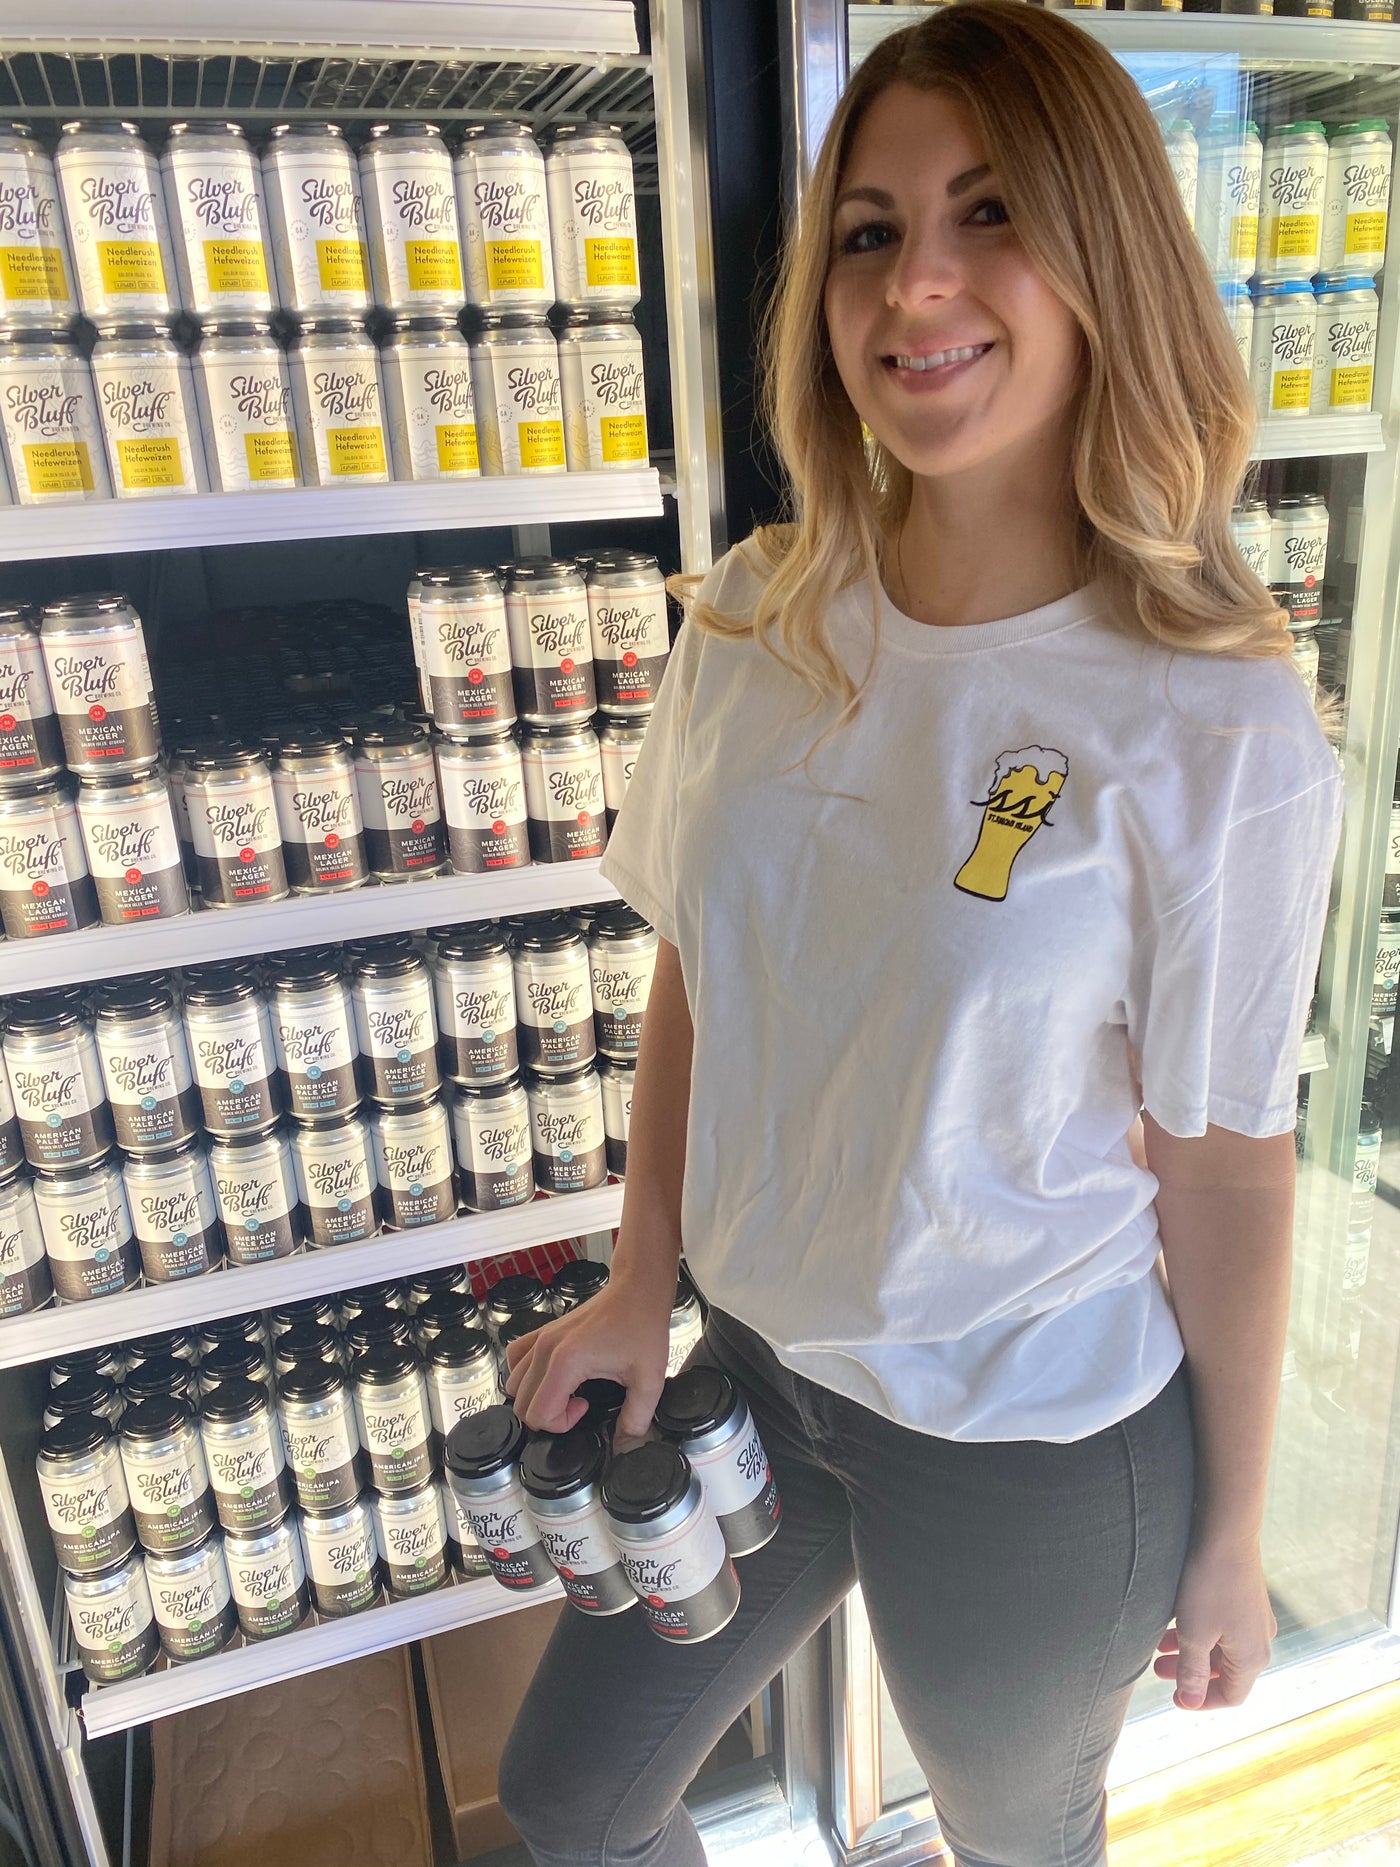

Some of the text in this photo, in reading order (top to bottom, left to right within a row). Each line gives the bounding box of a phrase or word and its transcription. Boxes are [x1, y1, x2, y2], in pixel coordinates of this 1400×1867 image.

[1269, 167, 1315, 188] Silver
[1343, 165, 1386, 186] Silver
[81, 178, 139, 203] Silver
[188, 178, 244, 203] Silver
[302, 179, 353, 203] Silver
[474, 182, 526, 206] Silver
[574, 180, 623, 205] Silver
[1272, 176, 1324, 206] Bluff
[1346, 174, 1390, 203] Bluff
[90, 194, 156, 228] Bluff
[196, 194, 259, 226] Bluff
[310, 197, 361, 227] Bluff
[480, 194, 540, 227] Bluff
[580, 193, 632, 224] Bluff
[107, 248, 155, 258] Needlerush
[213, 246, 258, 256] Needlerush
[493, 247, 535, 256] Needlerush
[594, 244, 631, 253] Needlerush
[594, 253, 631, 261] Hefeweizen
[109, 257, 156, 267] Hefeweizen
[214, 256, 259, 266] Hefeweizen
[494, 256, 536, 264] Hefeweizen
[1328, 323, 1370, 344] Silver
[1332, 329, 1376, 361] Bluff
[314, 372, 365, 394] Silver
[591, 364, 635, 386] Silver
[6, 384, 63, 409] Silver
[103, 381, 155, 404] Silver
[321, 382, 379, 416] Bluff
[597, 372, 644, 408] Bluff
[15, 395, 82, 430] Bluff
[111, 391, 175, 427] Bluff
[336, 433, 376, 442] Needlerush
[336, 442, 378, 450] Hefeweizen
[32, 450, 80, 458] Needlerush
[125, 444, 170, 453] Needlerush
[126, 454, 172, 462] Hefeweizen
[33, 458, 82, 467] Hefeweizen
[1284, 537, 1322, 554] Silver
[1288, 543, 1327, 570] Bluff
[531, 613, 576, 634] Silver
[596, 607, 641, 627] Silver
[439, 623, 486, 642] Silver
[537, 619, 586, 653] Bluff
[601, 614, 656, 644] Bluff
[444, 628, 500, 661] Bluff
[55, 656, 106, 678] Silver
[612, 670, 649, 680] MEXICAN
[62, 663, 125, 699] Bluff
[549, 677, 585, 687] MEXICAN
[555, 684, 582, 692] LAGER
[458, 687, 496, 697] MEXICAN
[78, 725, 123, 735] MEXICAN
[85, 733, 118, 741] LAGER
[381, 778, 426, 798] Silver
[464, 777, 509, 797] Silver
[388, 781, 434, 815] Bluff
[469, 781, 520, 815] Bluff
[206, 803, 256, 824] Silver
[92, 822, 142, 842] Silver
[214, 807, 270, 841] Bluff
[98, 826, 159, 862] Bluff
[401, 836, 435, 846] MEXICAN
[407, 842, 433, 851] LAGER
[482, 837, 517, 847] MEXICAN
[487, 843, 513, 852] LAGER
[229, 864, 269, 876] MEXICAN
[235, 872, 265, 882] LAGER
[115, 886, 158, 896] MEXICAN
[122, 893, 153, 902] LAGER
[593, 969, 630, 983] Silver
[597, 975, 646, 1001] Bluff
[369, 1010, 414, 1028] Silver
[374, 1011, 427, 1044] Bluff
[198, 1038, 246, 1058] Silver
[205, 1039, 261, 1075] Bluff
[109, 1055, 158, 1073] Silver
[116, 1055, 174, 1091] Bluff
[384, 1062, 426, 1074] AMERICAN
[408, 1068, 425, 1078] ALE
[15, 1071, 62, 1089] Silver
[21, 1072, 81, 1106] Bluff
[216, 1093, 261, 1106] AMERICAN
[219, 1099, 260, 1110] PALE ALE
[128, 1110, 174, 1122] AMERICAN
[130, 1116, 174, 1128] PALE ALE
[35, 1128, 81, 1138] AMERICAN
[63, 1134, 80, 1142] ALE
[383, 1146, 426, 1162] Silver
[388, 1146, 440, 1177] Bluff
[218, 1180, 260, 1195] Silver
[224, 1180, 277, 1211] Bluff
[141, 1192, 188, 1213] Silver
[148, 1191, 202, 1229] Bluff
[397, 1196, 438, 1207] AMERICAN
[399, 1201, 437, 1212] PALE ALE
[234, 1231, 276, 1242] AMERICAN
[260, 1236, 275, 1244] ALE
[160, 1244, 203, 1259] AMERICAN
[162, 1250, 203, 1263] PALE ALE
[366, 1413, 407, 1429] Silver
[371, 1410, 420, 1443] Bluff
[213, 1450, 255, 1468] Silver
[219, 1449, 270, 1482] Bluff
[374, 1454, 424, 1469] AMERICAN IPA
[138, 1468, 182, 1488] Silver
[143, 1464, 196, 1504] Bluff
[222, 1492, 276, 1508] AMERICAN IPA
[148, 1509, 202, 1529] AMERICAN IPA
[389, 1523, 428, 1542] Silver
[394, 1519, 439, 1555] Bluff
[240, 1564, 282, 1583] Silver
[245, 1560, 293, 1597] Bluff
[396, 1559, 443, 1579] AMERICAN IPA
[160, 1585, 203, 1604] Silver
[166, 1581, 217, 1618] Bluff
[248, 1602, 300, 1622] AMERICAN IPA
[170, 1623, 224, 1644] AMERICAN IPA
